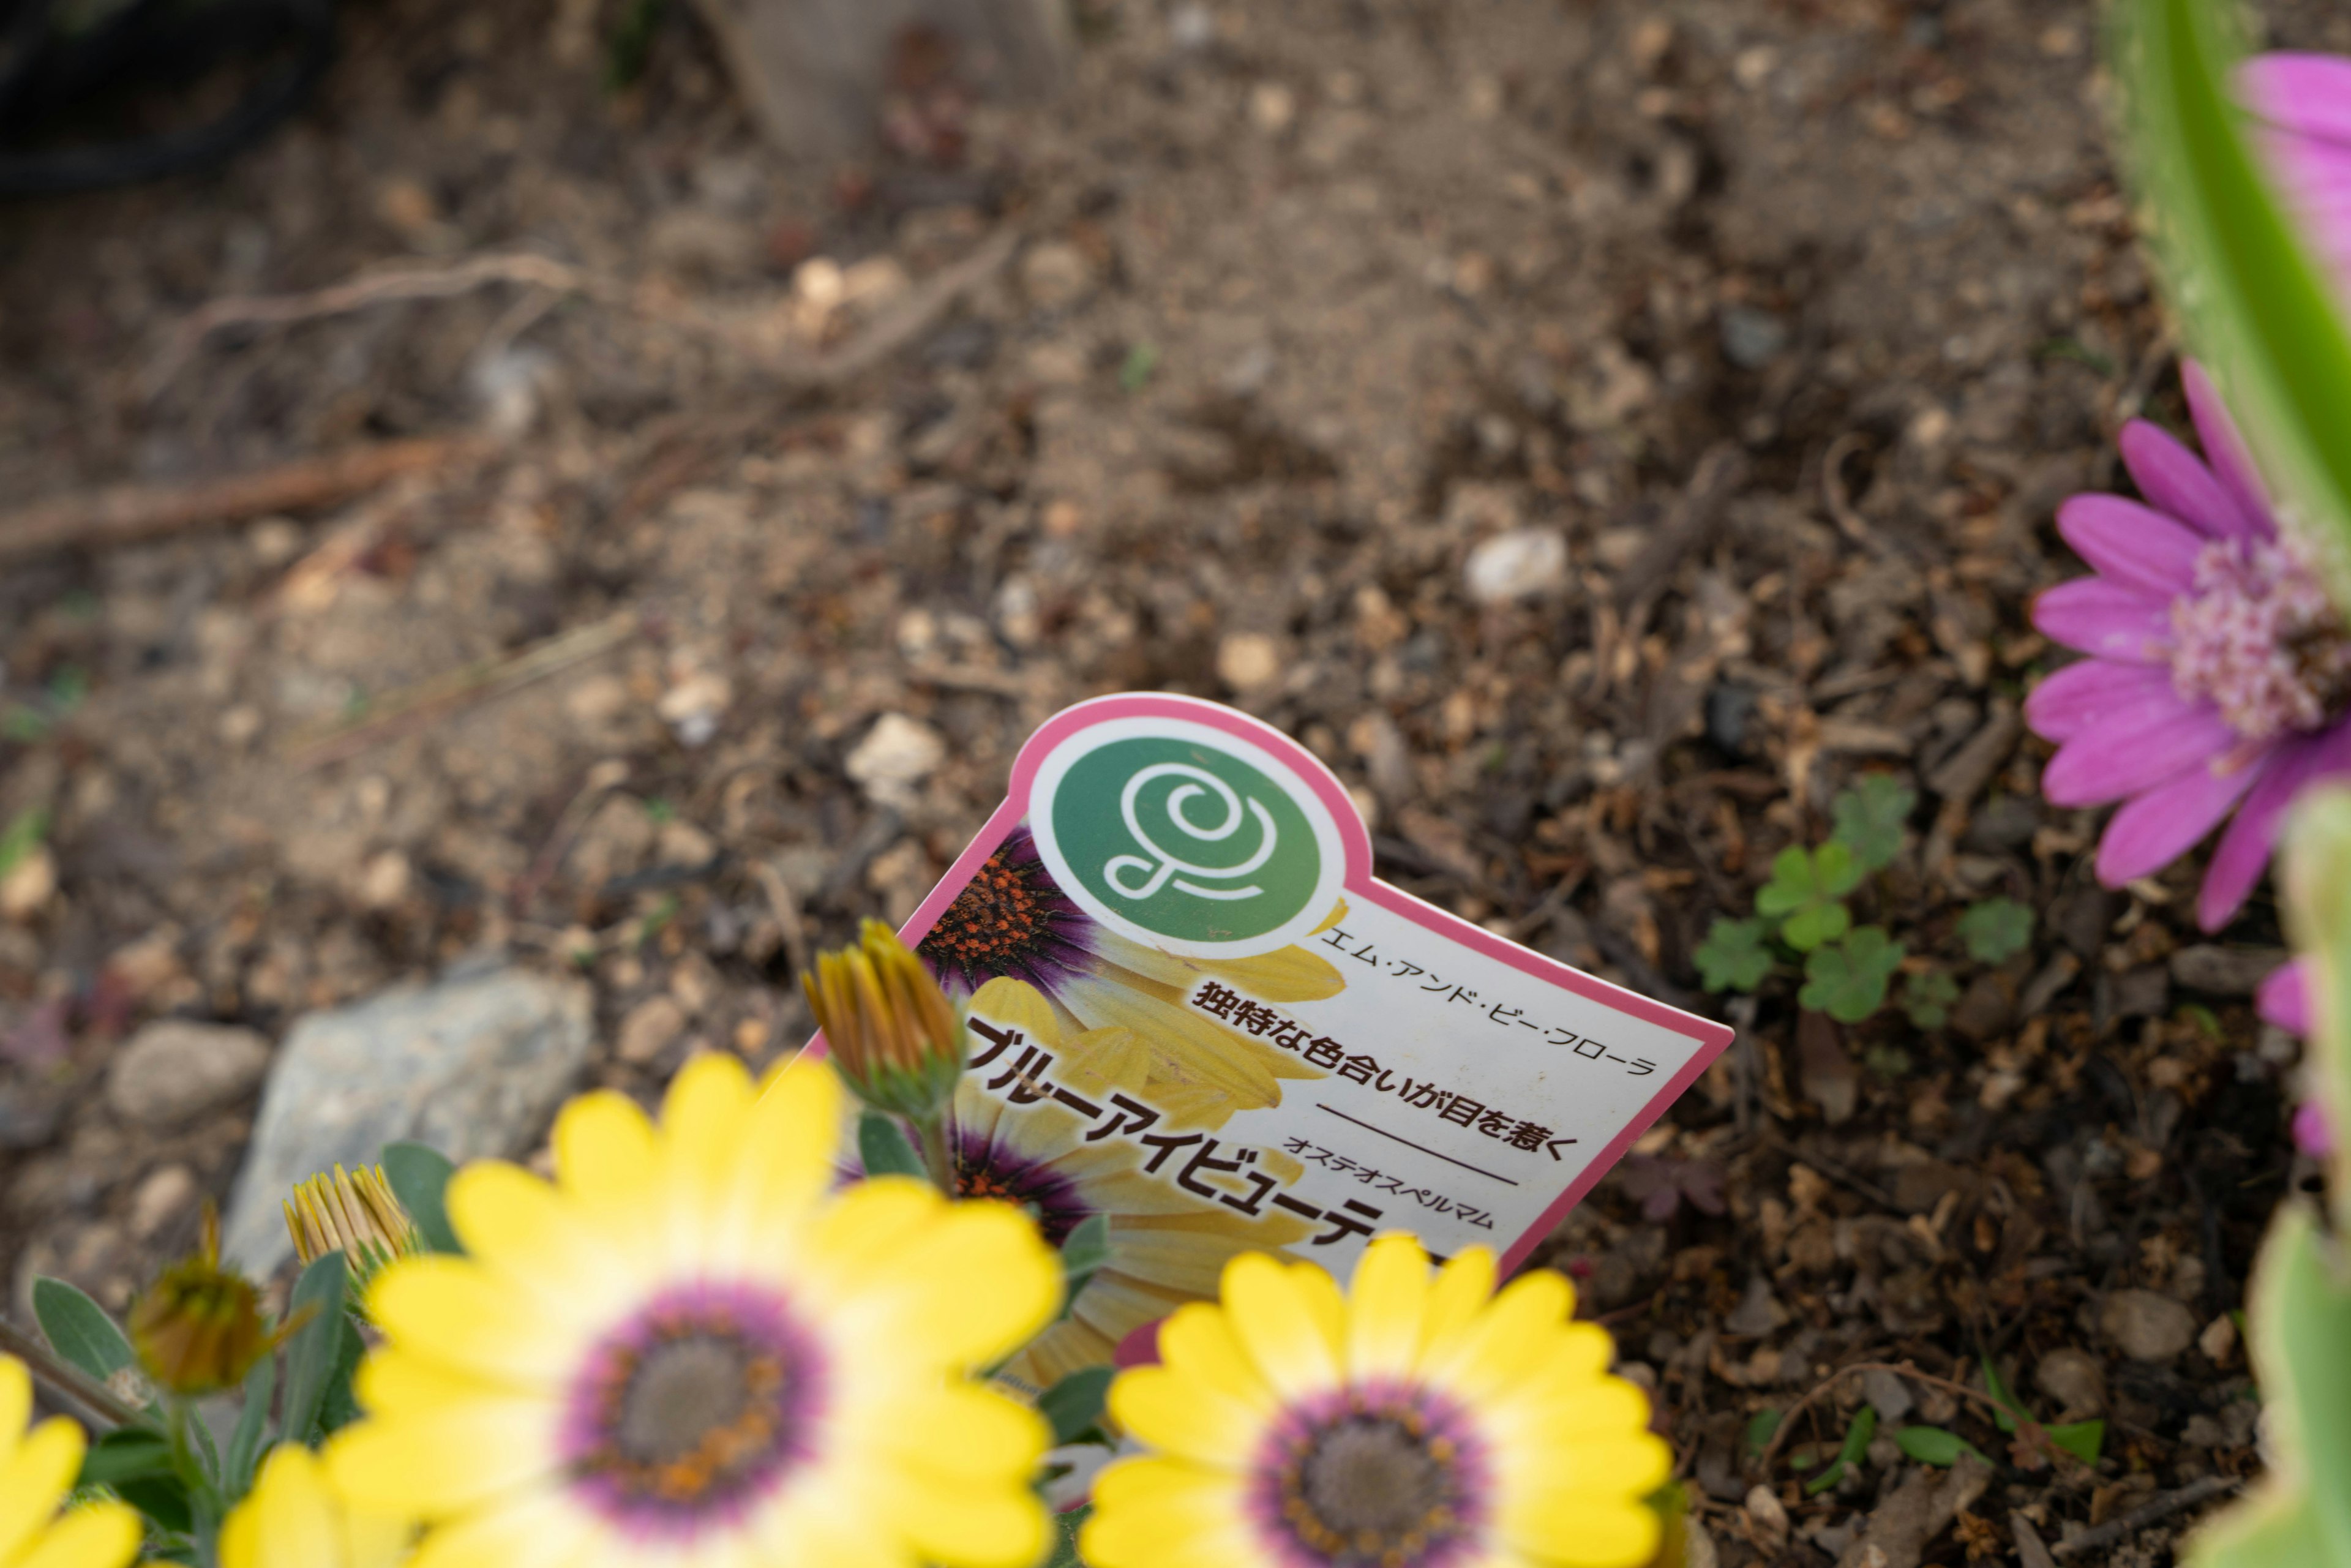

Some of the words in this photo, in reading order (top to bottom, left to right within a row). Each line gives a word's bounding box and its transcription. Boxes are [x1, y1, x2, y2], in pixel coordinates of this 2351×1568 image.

[1191, 981, 1578, 1161] 独特な色合いが目を惹く
[1321, 927, 1657, 1076] エム・アンド・ビー・フローラ
[966, 1016, 1459, 1269] ブルーアイビューテ
[1283, 1136, 1494, 1230] オステオスペルマム
